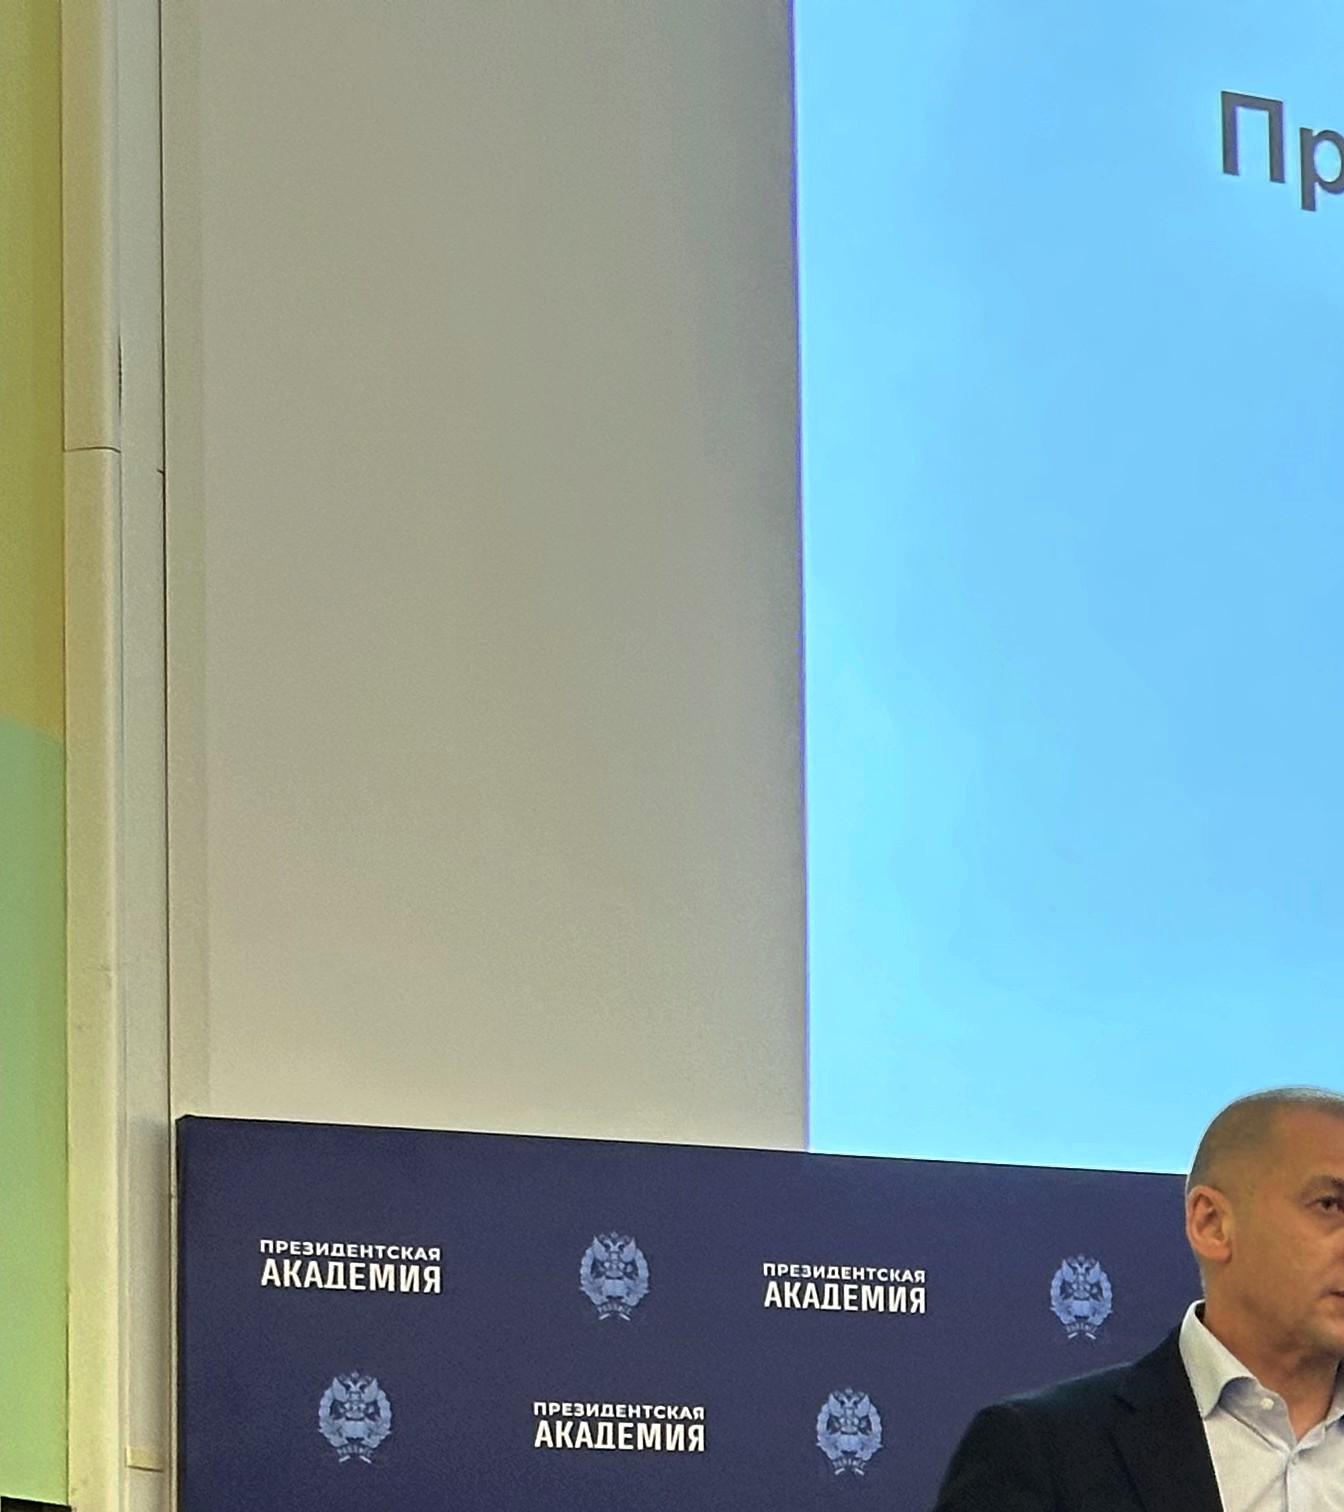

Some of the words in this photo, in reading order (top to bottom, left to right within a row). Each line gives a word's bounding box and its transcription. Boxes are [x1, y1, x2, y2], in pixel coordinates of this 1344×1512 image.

[261, 1240, 440, 1261] ПРЕЗИДЕНТСКАЯ
[262, 1258, 440, 1293] АКАДЕМИЯ
[764, 1263, 925, 1283] ПРЕЗИДЕНТСКАЯ
[764, 1281, 925, 1313] АКАДЕМИЯ
[534, 1402, 704, 1420] ПРЕЗИДЕНТСКАЯ
[535, 1420, 704, 1451] АКАДЕМИЯ
